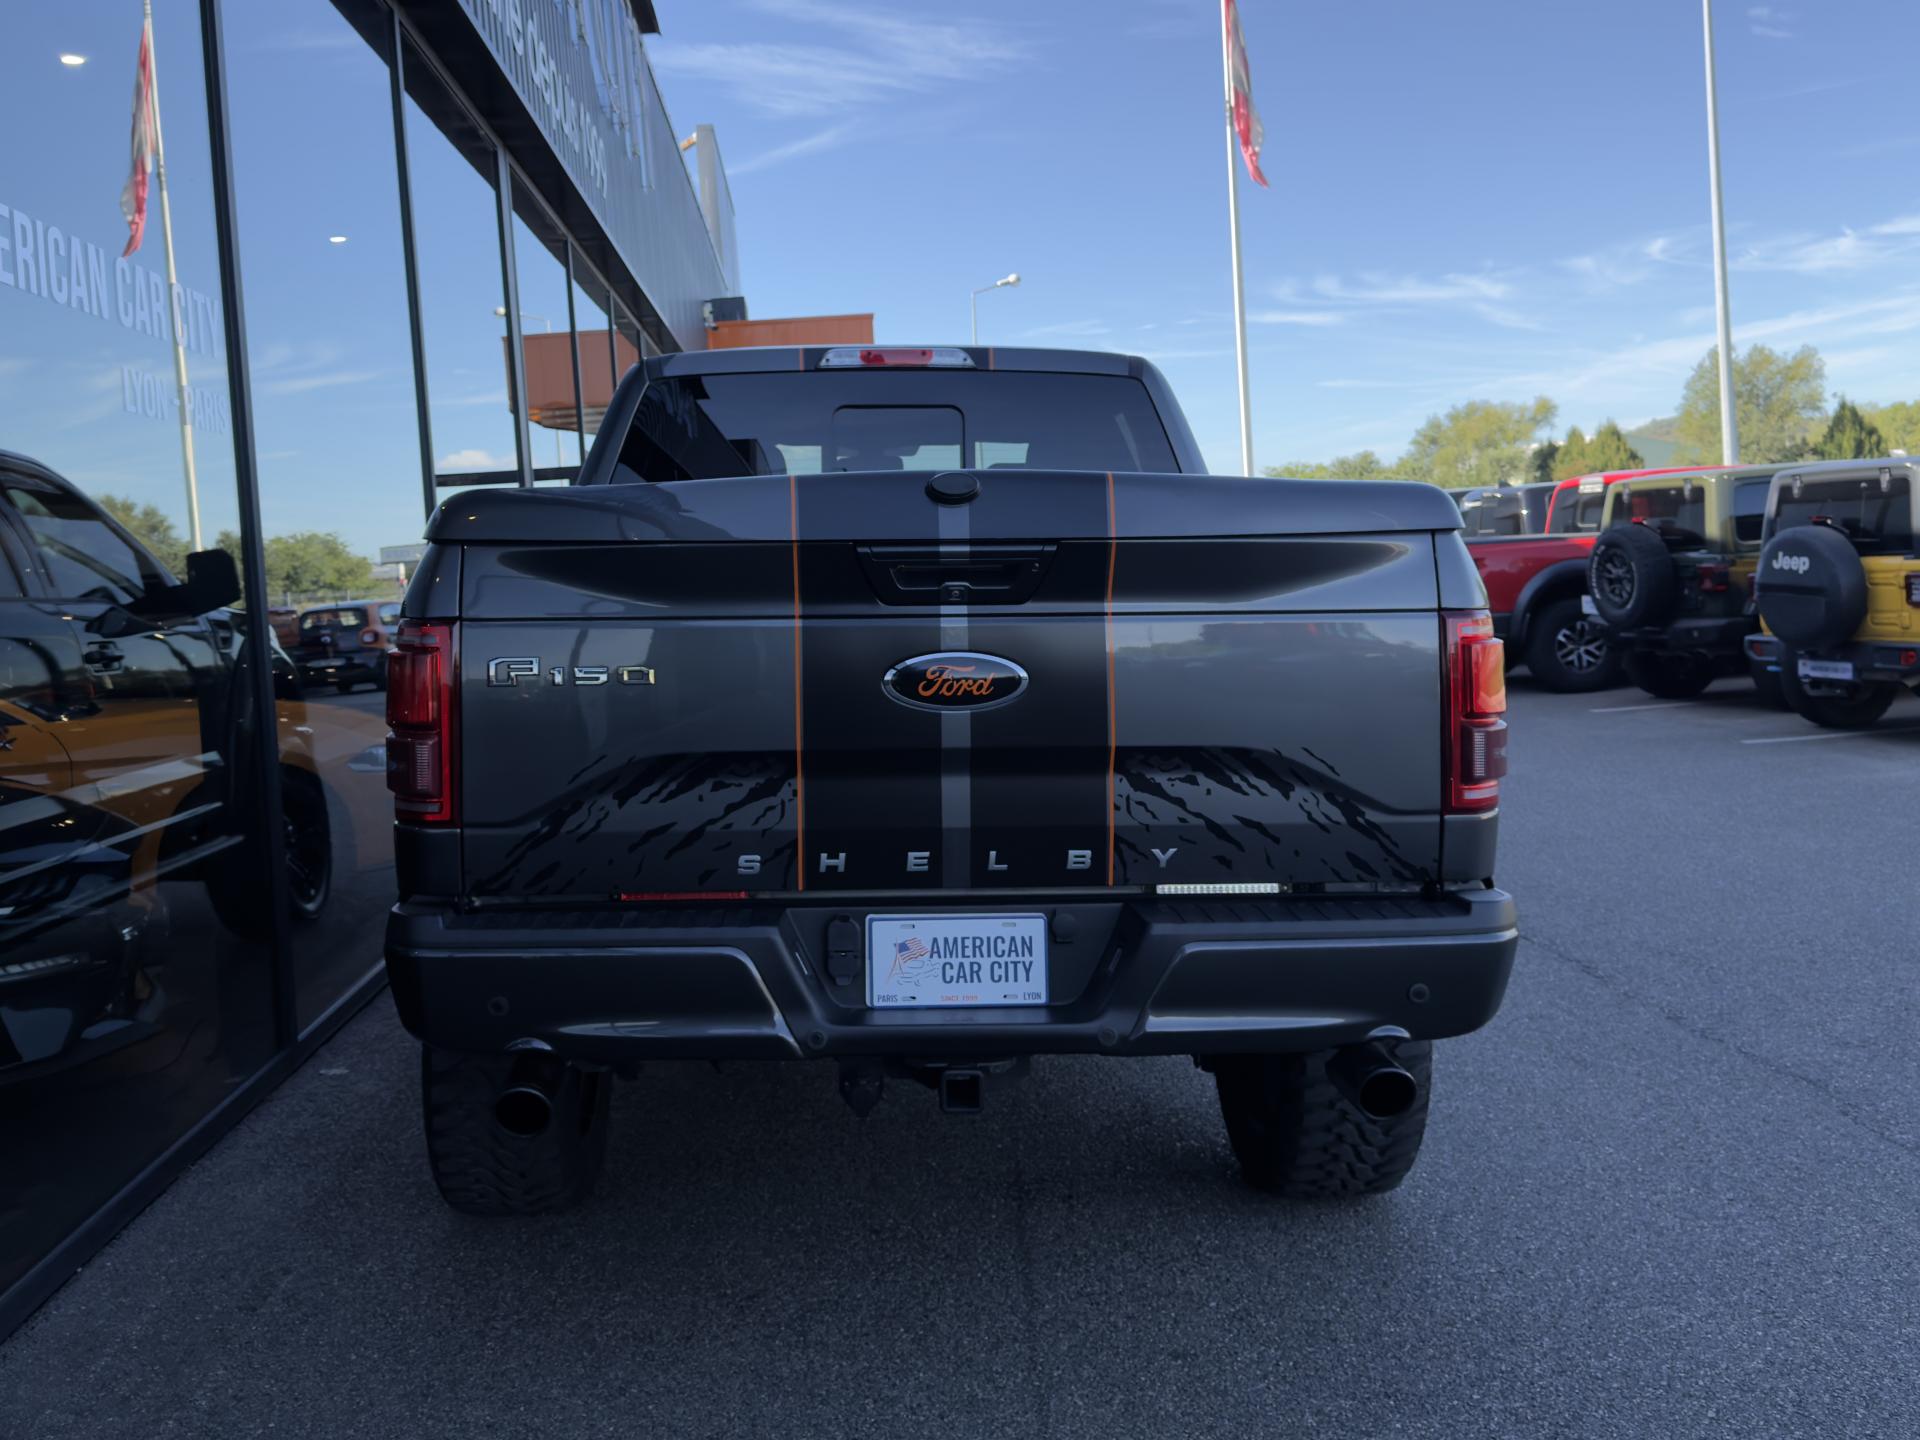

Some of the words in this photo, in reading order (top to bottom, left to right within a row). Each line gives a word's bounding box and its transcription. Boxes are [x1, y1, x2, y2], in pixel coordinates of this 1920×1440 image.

[115, 256, 168, 341] CAR
[172, 281, 221, 358] CITY
[121, 364, 168, 420] LYON
[184, 384, 228, 432] PARIS
[1772, 551, 1810, 574] Jeep
[918, 664, 995, 697] Ford
[737, 847, 1178, 875] SHELBY
[929, 935, 1034, 959] AMERICAN
[941, 961, 982, 984] CAR
[989, 960, 1034, 983] CITY
[877, 994, 898, 1003] PARIS
[1023, 991, 1042, 1001] LYON
